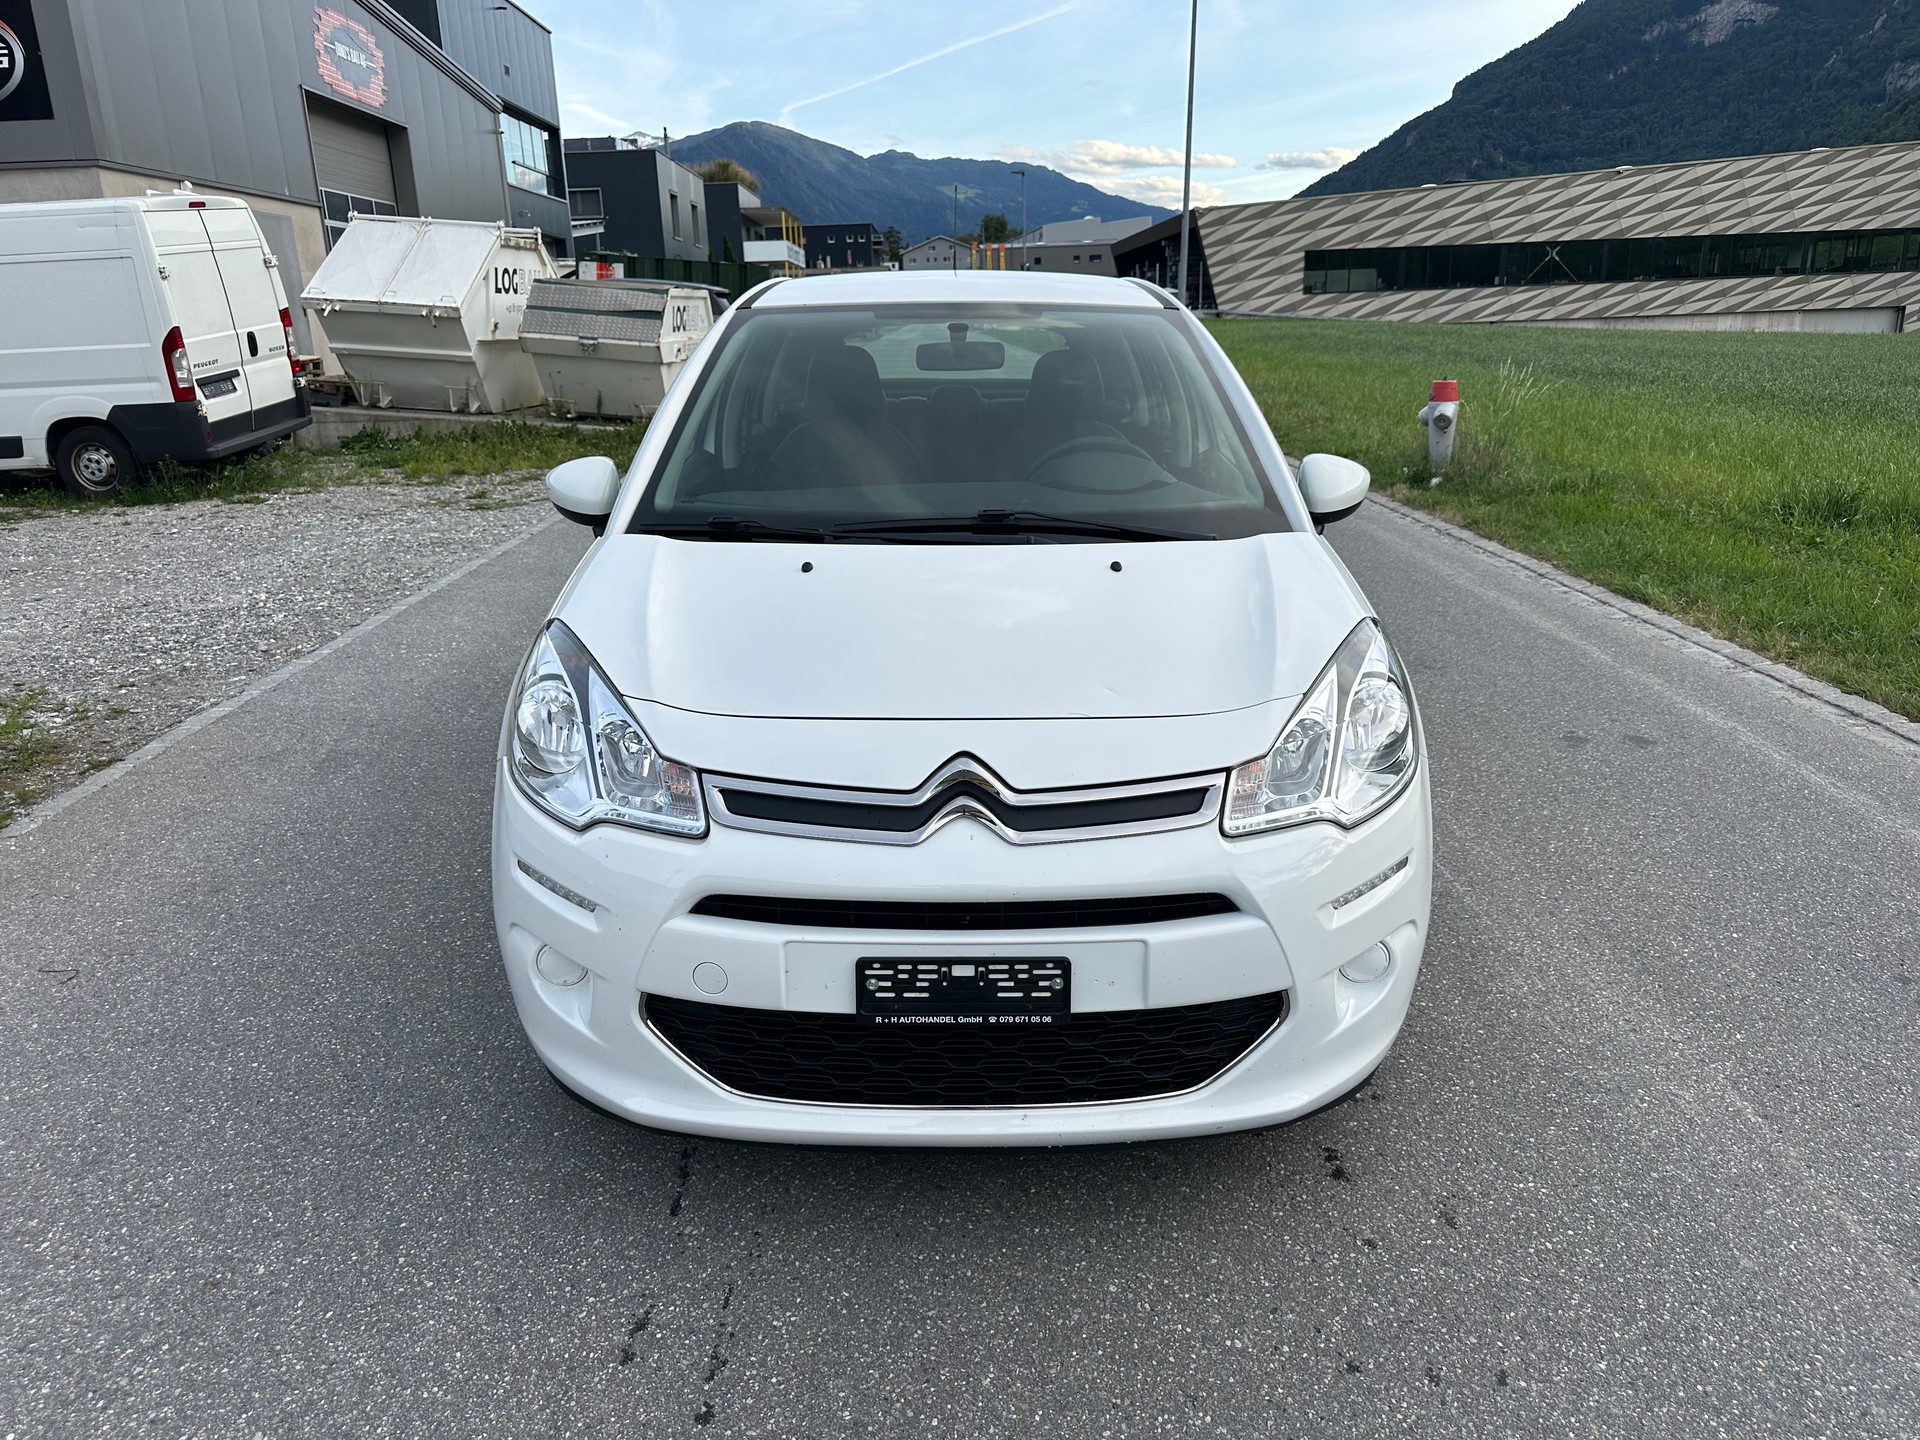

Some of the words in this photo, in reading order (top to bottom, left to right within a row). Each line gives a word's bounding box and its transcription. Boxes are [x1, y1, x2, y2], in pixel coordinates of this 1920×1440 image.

[193, 359, 219, 369] PEUGEOT
[875, 1016, 882, 1024] R
[890, 1016, 898, 1024] H
[899, 1016, 956, 1024] AUTOHANDEL
